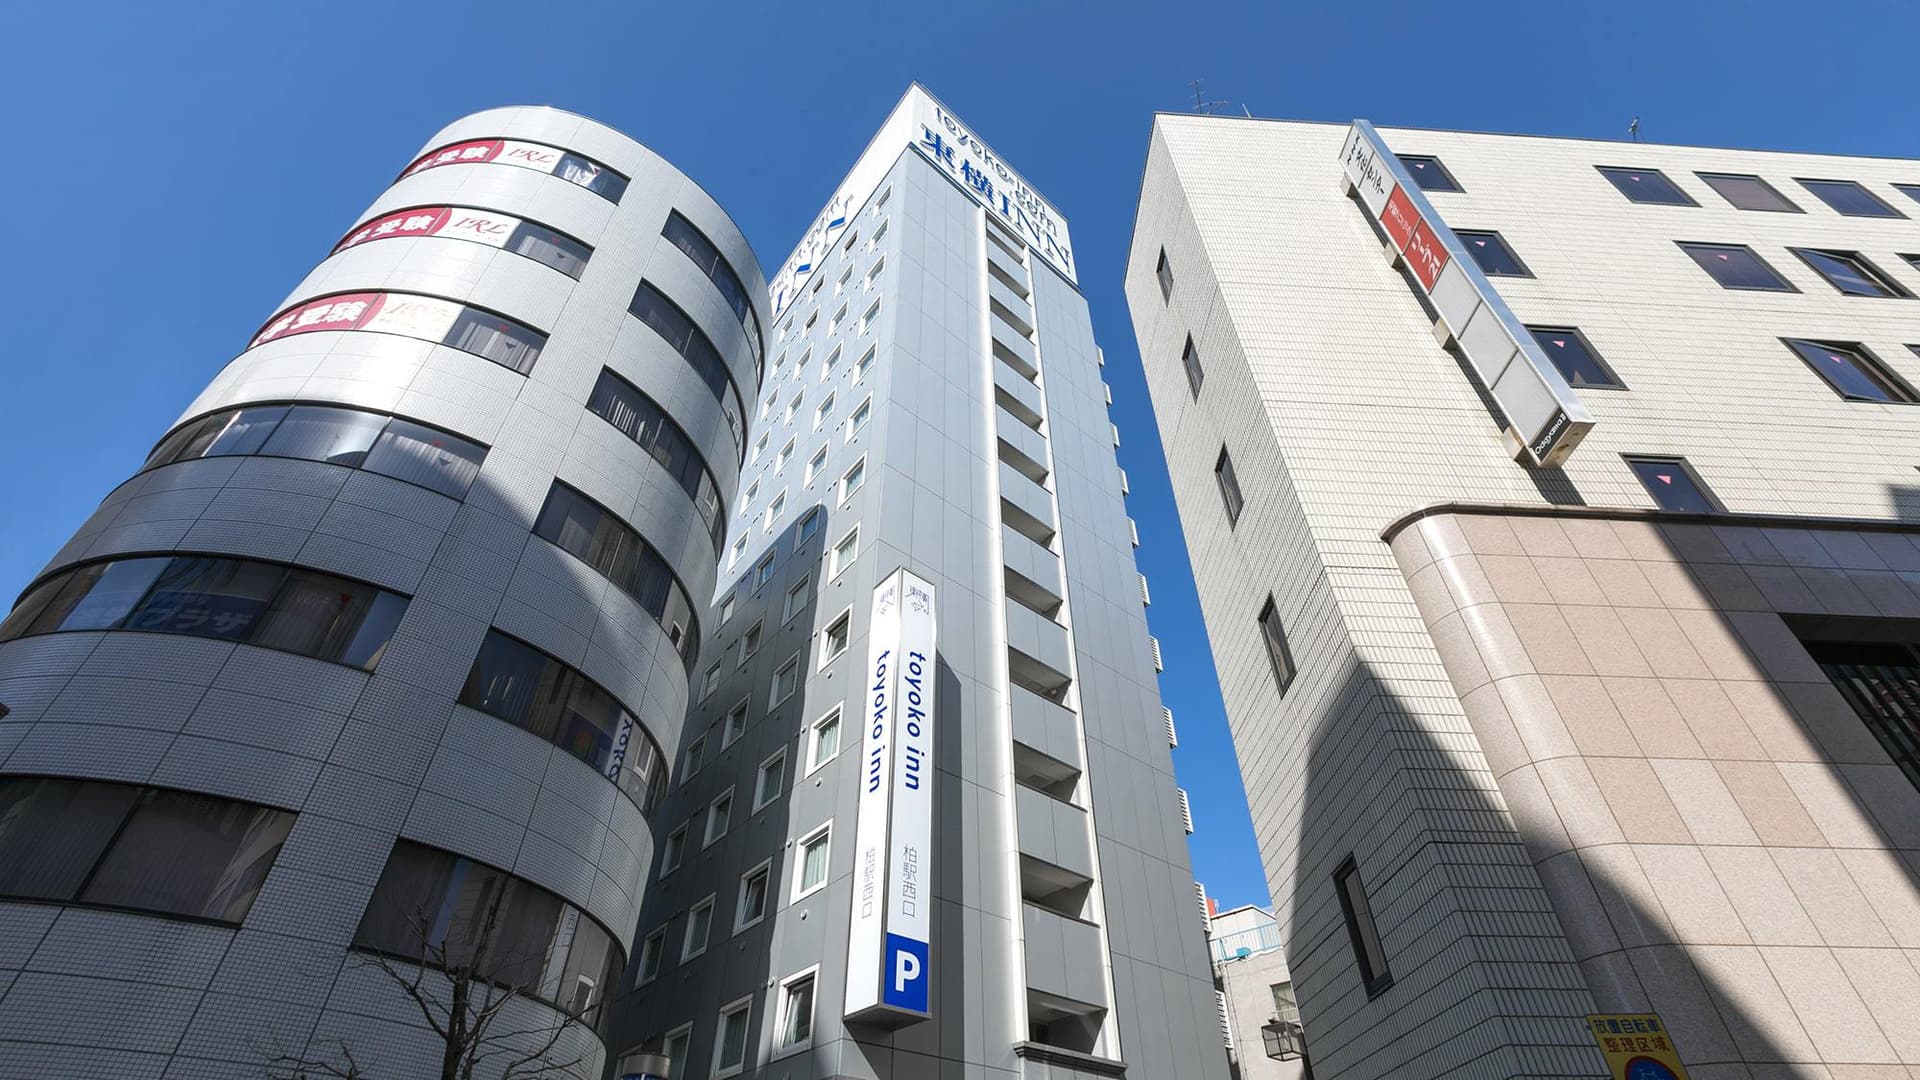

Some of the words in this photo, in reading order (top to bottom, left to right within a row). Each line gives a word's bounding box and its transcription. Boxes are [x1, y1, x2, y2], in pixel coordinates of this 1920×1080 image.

[872, 649, 891, 740] toyoko
[904, 650, 927, 738] toyoko
[869, 745, 886, 793] inn
[905, 745, 926, 791] inn
[903, 844, 918, 918] 柏駅西口
[895, 949, 920, 992] P
